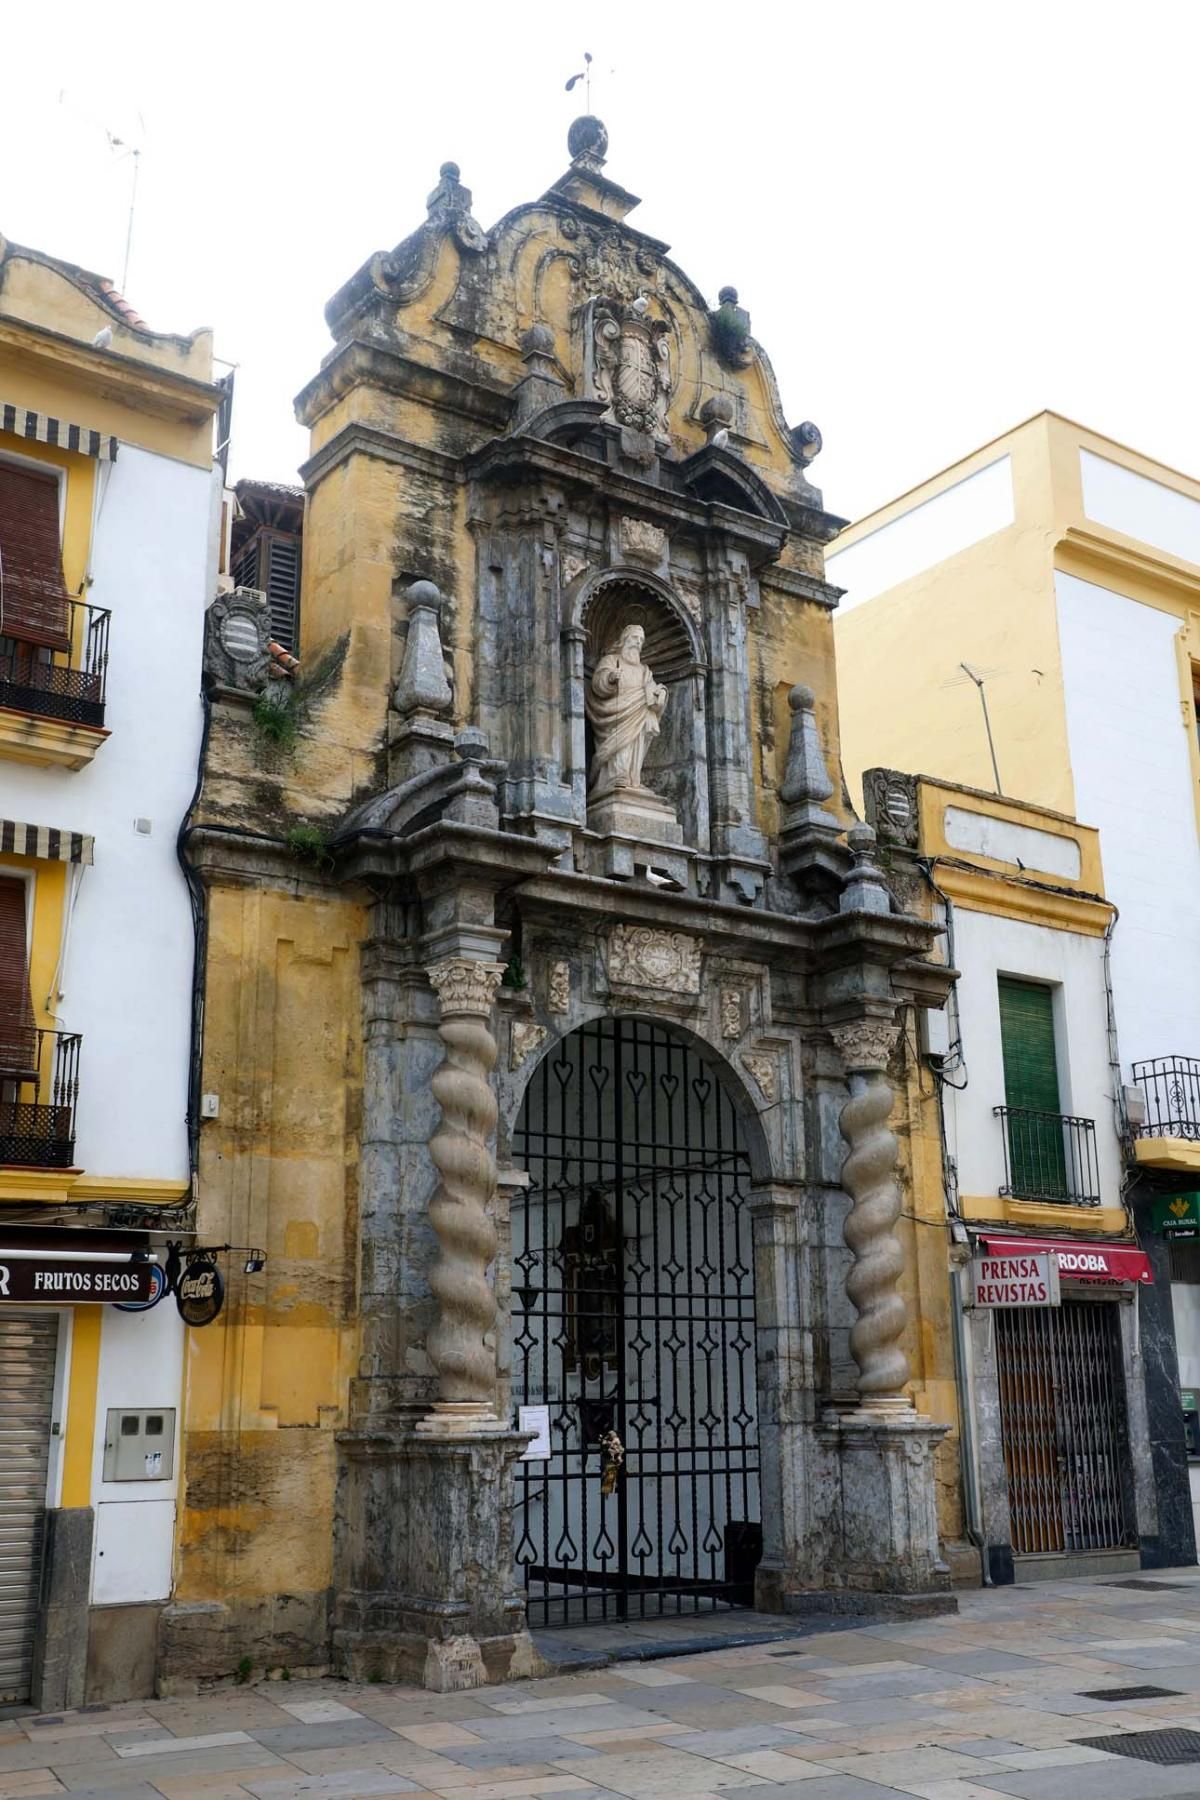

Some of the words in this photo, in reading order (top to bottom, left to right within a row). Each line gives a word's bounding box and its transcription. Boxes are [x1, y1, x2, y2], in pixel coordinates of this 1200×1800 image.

[981, 1258, 1040, 1280] PRENSA
[1041, 1249, 1109, 1272] RDOBA
[34, 1271, 90, 1291] FRUTOS
[94, 1273, 140, 1291] SECOS
[976, 1282, 1047, 1304] REVISTAS
